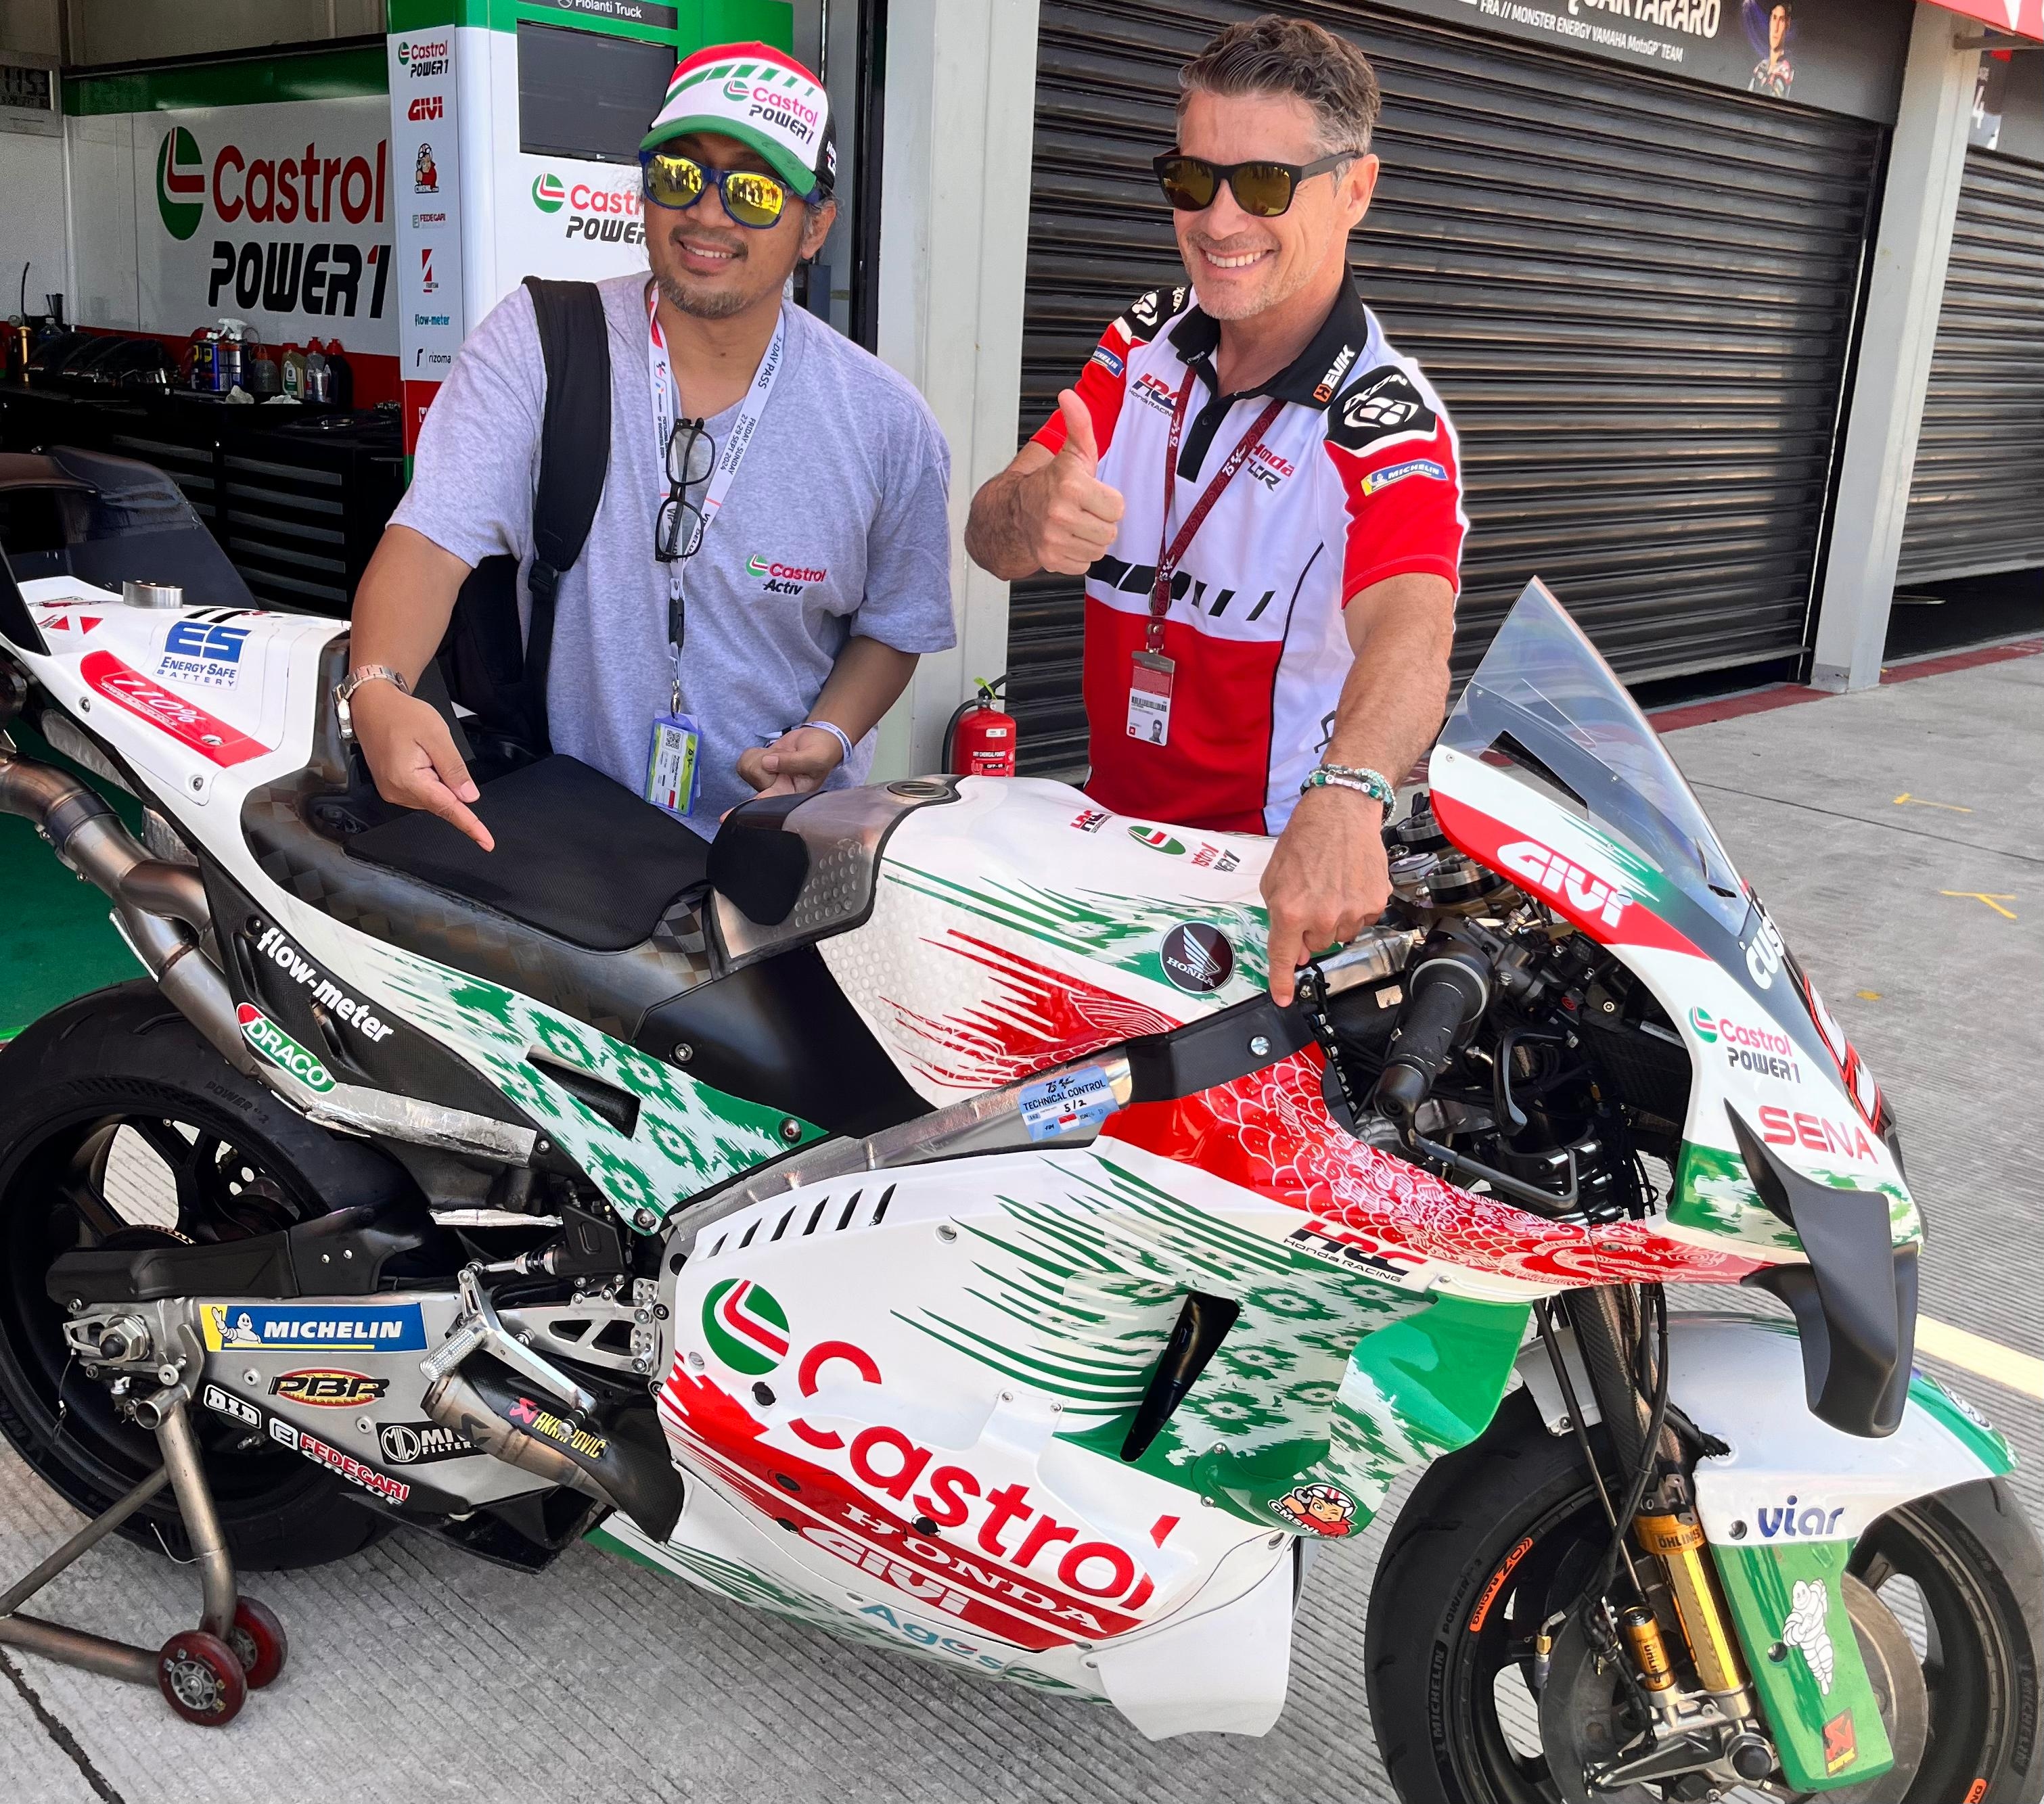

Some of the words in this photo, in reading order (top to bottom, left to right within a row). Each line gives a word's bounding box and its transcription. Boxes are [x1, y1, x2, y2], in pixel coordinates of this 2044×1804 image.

[615, 3, 642, 18] Truck
[1480, 0, 1499, 16] FRA
[1511, 4, 1555, 31] MONSTER
[1556, 16, 1591, 39] ENERGY
[1592, 26, 1626, 49] YAMAHA
[1660, 45, 1684, 62] TEAM
[411, 39, 448, 60] Castrol
[411, 60, 449, 78] POWER1
[408, 96, 442, 121] GIVI
[753, 87, 818, 127] Castrol
[748, 104, 814, 144] POWER1
[212, 139, 387, 224] Castrol
[208, 241, 391, 319] POWER1
[429, 352, 451, 363] rizoma
[769, 333, 782, 364] 3-DAY
[758, 362, 776, 389] PASS
[1149, 400, 1174, 417] RACIN
[735, 413, 748, 436] 27-29
[743, 417, 756, 444] FRIDAY
[729, 435, 740, 453] SEPT
[720, 451, 732, 471] 2024
[729, 447, 744, 476] SUNDAY
[1222, 462, 1234, 476] 75
[1388, 463, 1440, 480] MICHELIN
[763, 579, 803, 595] Activ
[769, 562, 827, 582] Castrol
[164, 621, 252, 663] ES
[1497, 841, 1631, 928] GIVI
[256, 927, 394, 1042] flow-meter
[1166, 957, 1215, 988] HONDA
[246, 1017, 328, 1087] DRACO
[1721, 1018, 1793, 1058] Castrol
[1727, 1046, 1801, 1084] POWER1
[206, 1081, 253, 1111] POWER
[1023, 1092, 1067, 1111] TECHNICAL
[1068, 1080, 1106, 1097] CONTROL
[1758, 1105, 1879, 1165] SENA
[1284, 1238, 1340, 1264] Honda
[1342, 1259, 1403, 1284] RACING
[1290, 1220, 1428, 1276] HRC
[263, 1320, 403, 1339] MICHELIN
[267, 1376, 390, 1398] PBR
[422, 1441, 478, 1455] FILTER
[300, 1432, 411, 1502] FEDEGARI
[301, 1450, 406, 1506] GROUP
[788, 1341, 1180, 1610] Castrol
[1758, 1496, 1844, 1538] viar
[798, 1526, 969, 1615] GIVI
[842, 1502, 1107, 1634] HONDA
[1472, 1577, 1498, 1625] RACING
[1429, 1650, 1446, 1738] MICHELIN
